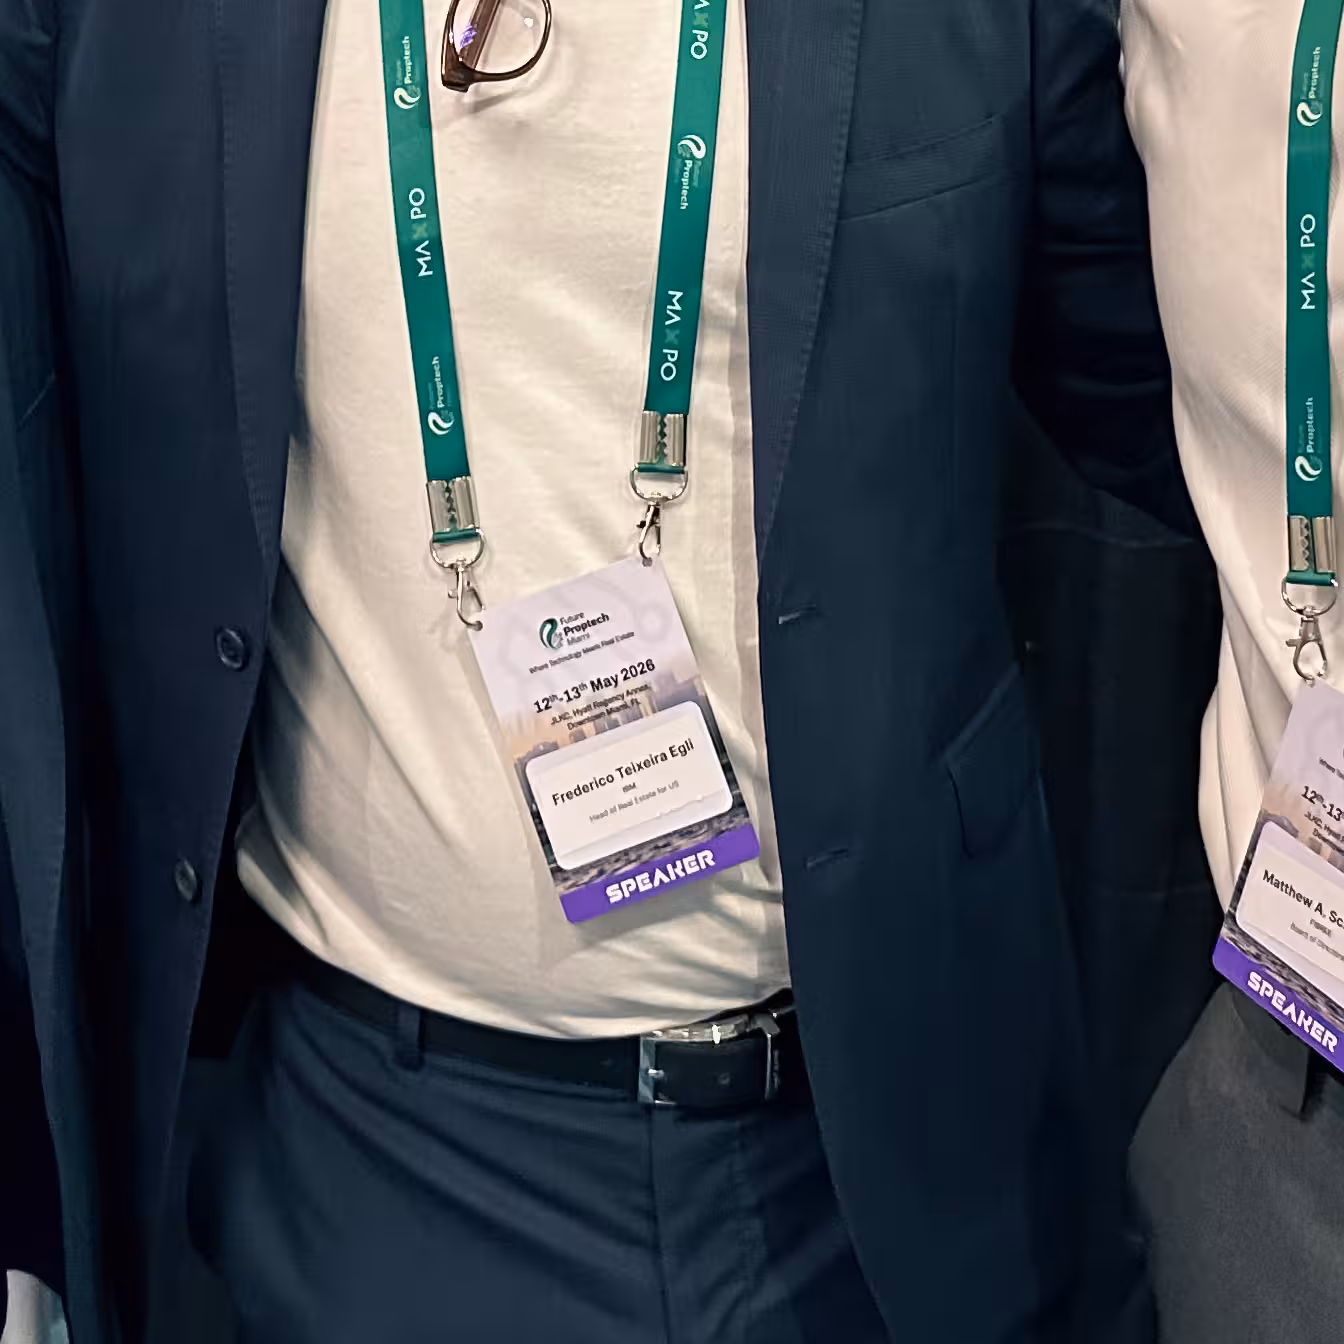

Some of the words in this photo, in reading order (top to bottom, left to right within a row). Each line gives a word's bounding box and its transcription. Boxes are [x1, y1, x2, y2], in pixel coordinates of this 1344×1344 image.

[403, 36, 412, 84] Proptech
[1308, 46, 1321, 99] Proptech
[680, 159, 692, 210] Proptech
[432, 356, 444, 408] Proptech
[1305, 397, 1315, 453] Proptech
[563, 613, 609, 636] Proptech
[590, 675, 618, 692] May
[621, 659, 655, 681] 2026
[552, 775, 614, 805] Frederico
[615, 753, 667, 778] Teixeira
[669, 738, 694, 757] Egli
[605, 849, 716, 904] SPEAKER
[1263, 870, 1313, 908] Matthew
[1314, 903, 1326, 917] A.
[1247, 971, 1339, 1053] SPEAKER
